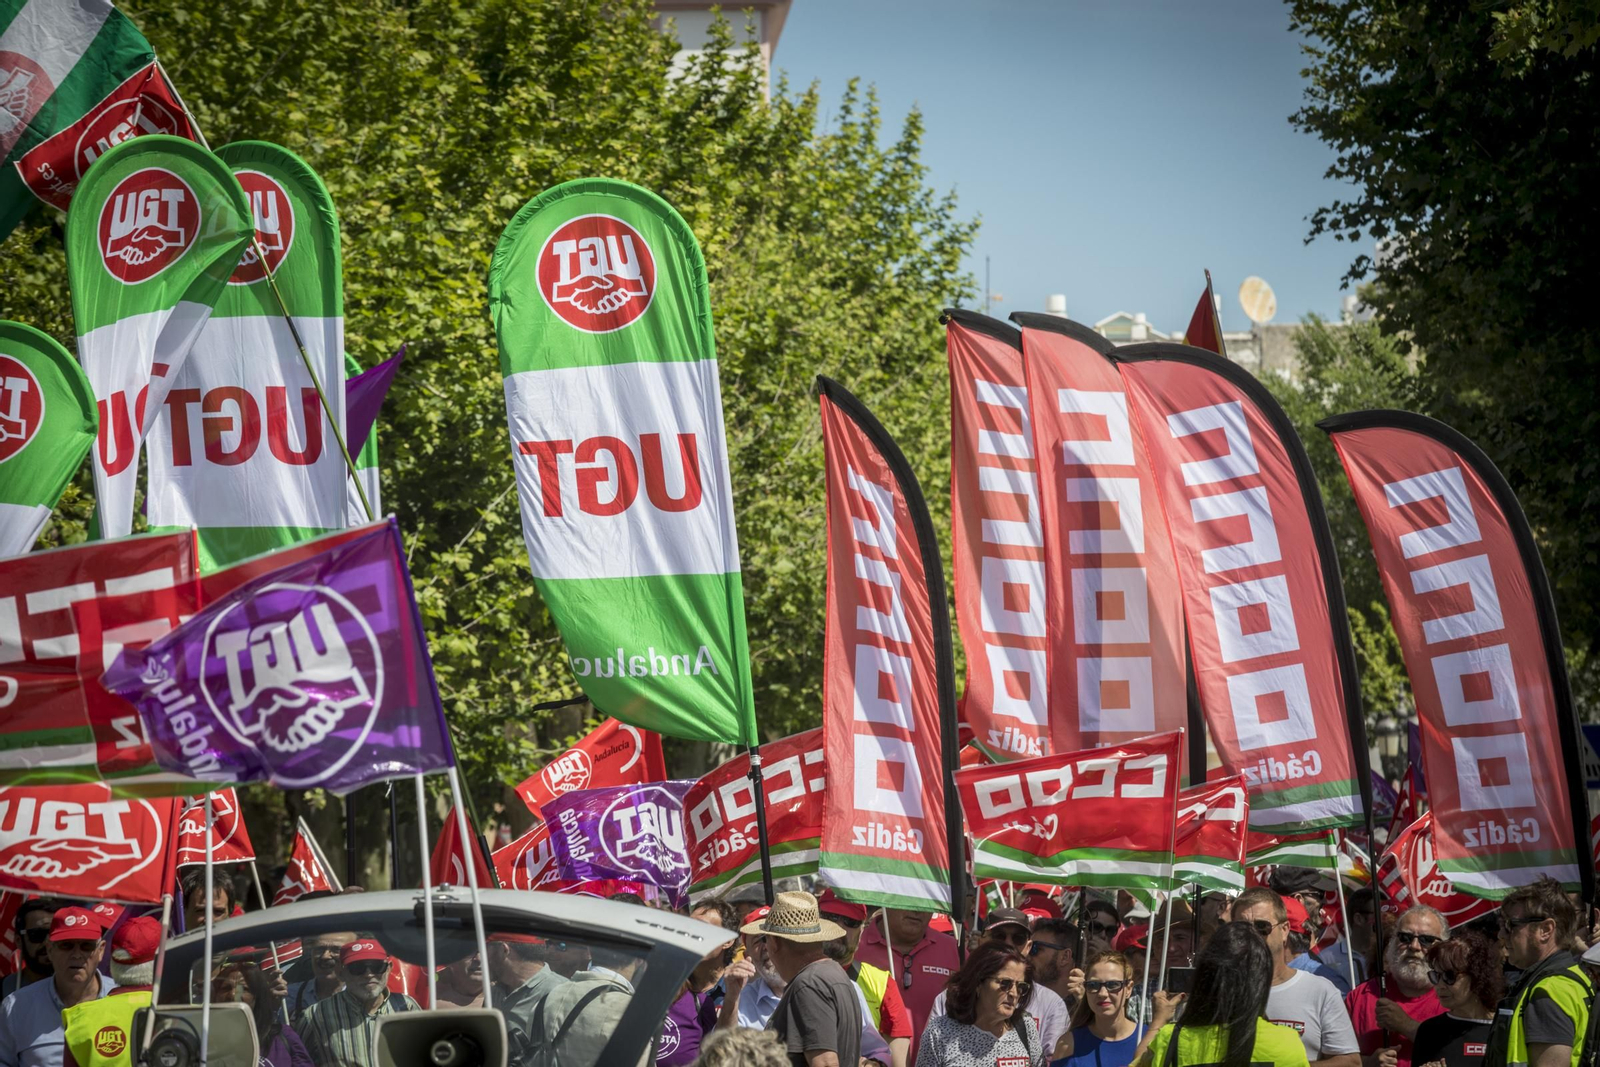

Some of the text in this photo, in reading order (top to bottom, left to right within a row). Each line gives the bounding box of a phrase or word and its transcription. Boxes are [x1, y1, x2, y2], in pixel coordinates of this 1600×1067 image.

[110, 188, 186, 238] UGT
[594, 740, 630, 764] Andalucía
[546, 751, 588, 783] UGT
[0, 797, 131, 843] UGT
[922, 965, 950, 976] CCOO
[98, 1030, 122, 1044] UGT
